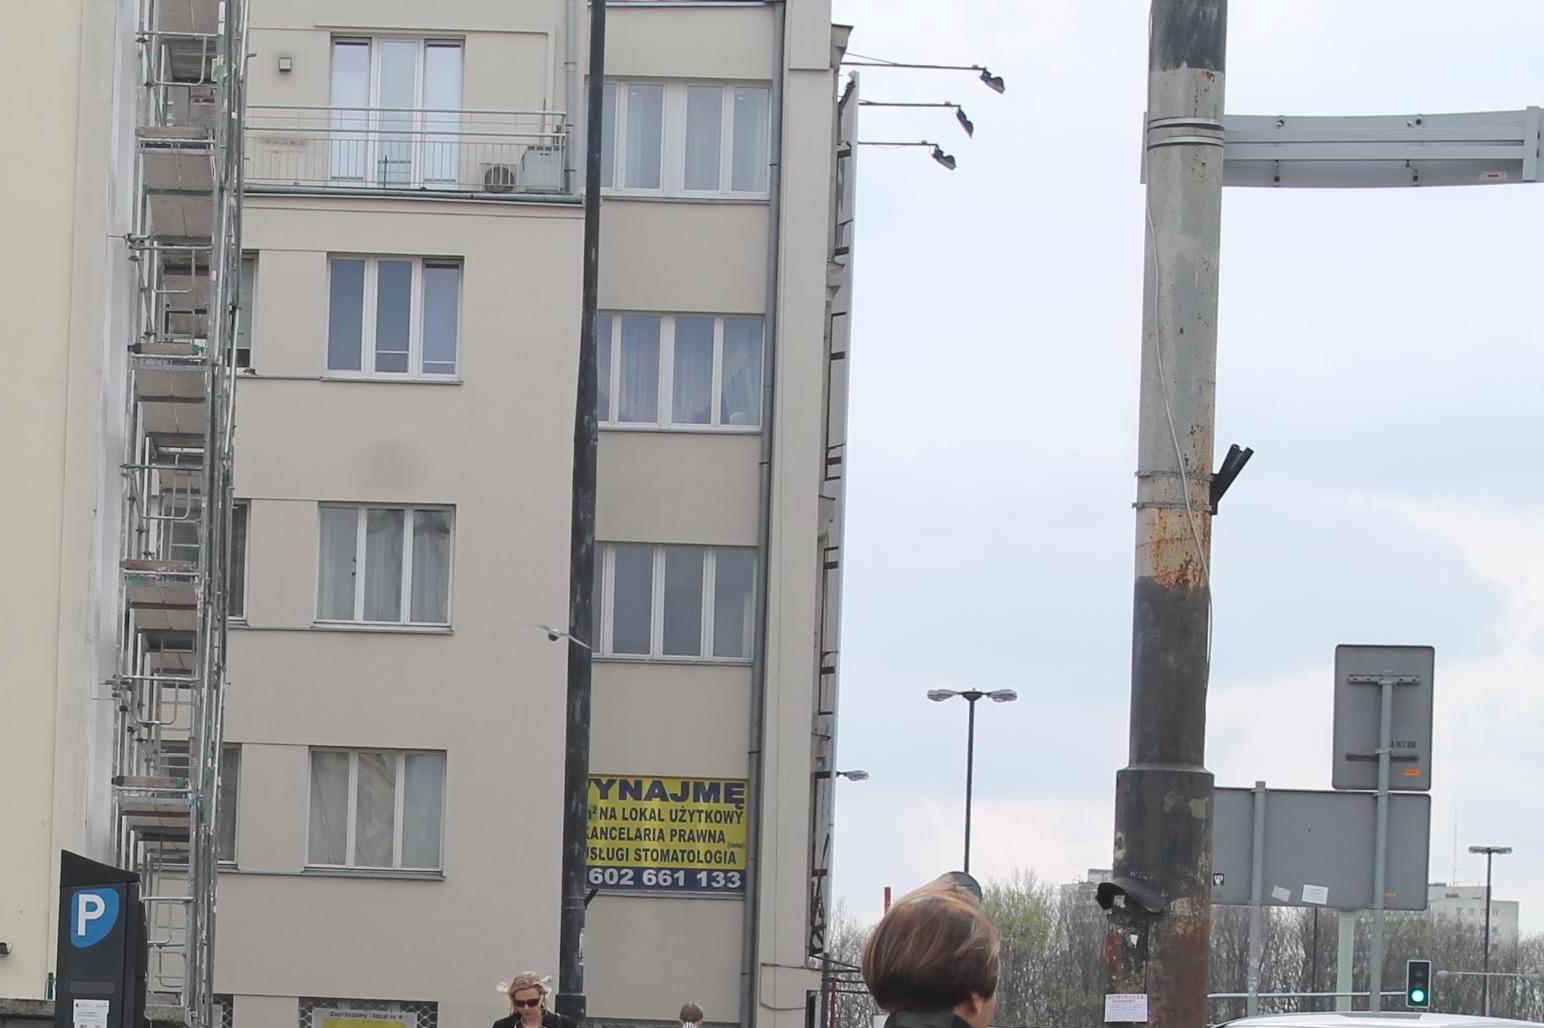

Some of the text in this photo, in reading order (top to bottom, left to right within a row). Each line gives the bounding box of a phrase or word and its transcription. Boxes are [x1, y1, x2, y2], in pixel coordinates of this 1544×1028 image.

[600, 807, 617, 821] NA
[622, 807, 665, 822] LOKAL
[669, 806, 744, 825] UŻYTKOWY
[670, 828, 726, 844] PRAWNA
[634, 848, 737, 865] STOMATOLOGIA
[589, 868, 741, 888] 602 661 133
[77, 893, 105, 936] P
